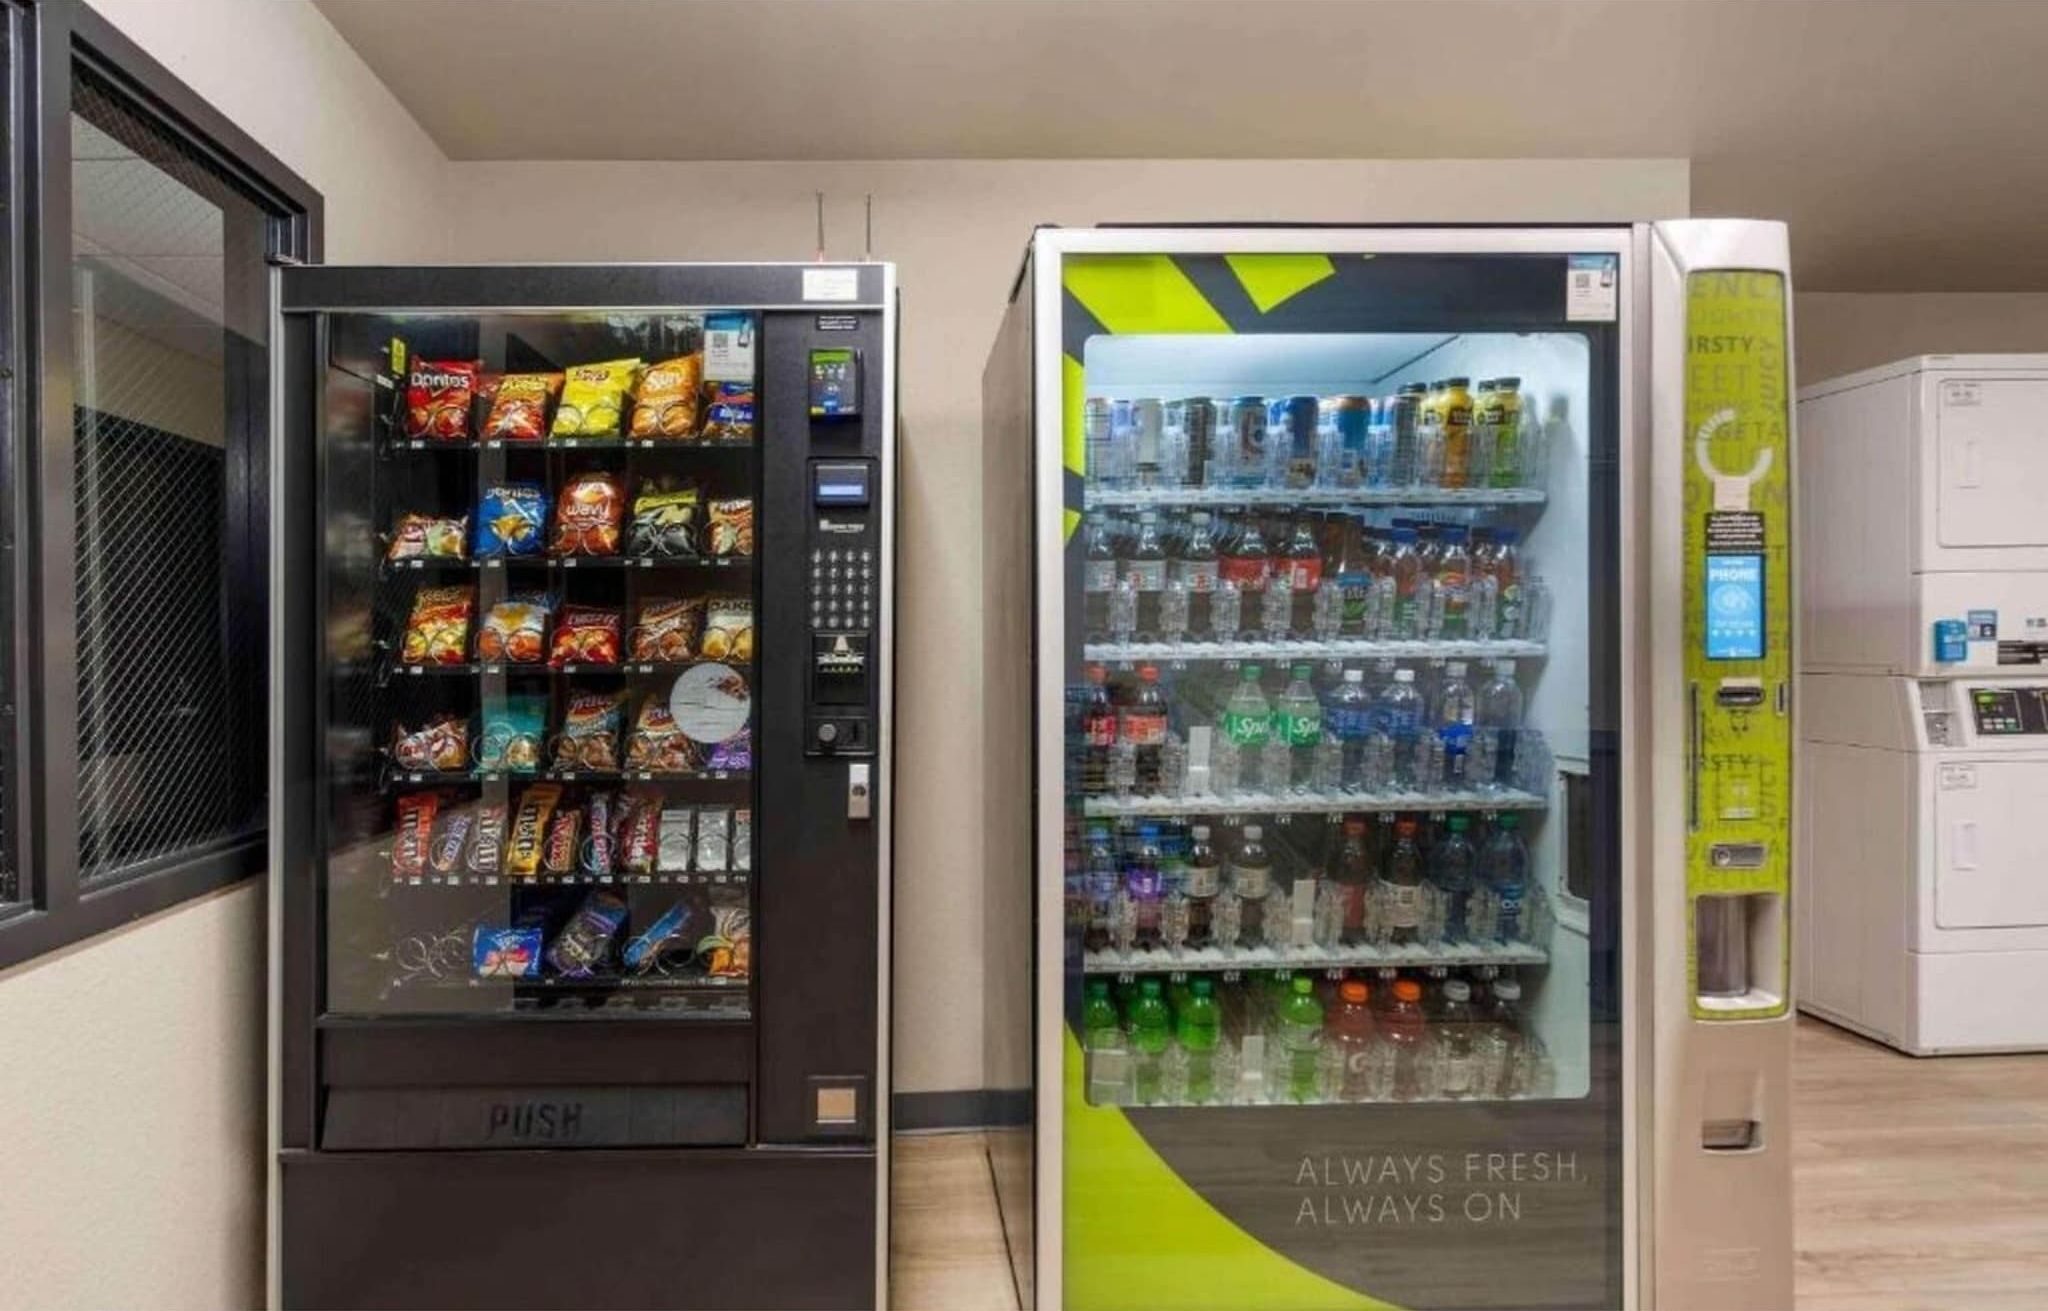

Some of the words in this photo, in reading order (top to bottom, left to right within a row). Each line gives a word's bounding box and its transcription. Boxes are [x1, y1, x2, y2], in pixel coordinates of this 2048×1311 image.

[411, 371, 469, 389] Doritos
[489, 1102, 583, 1139] PUSH
[1295, 1154, 1446, 1185] ALWAYS
[1295, 1194, 1446, 1224] ALWAYS
[1464, 1192, 1521, 1222] ON
